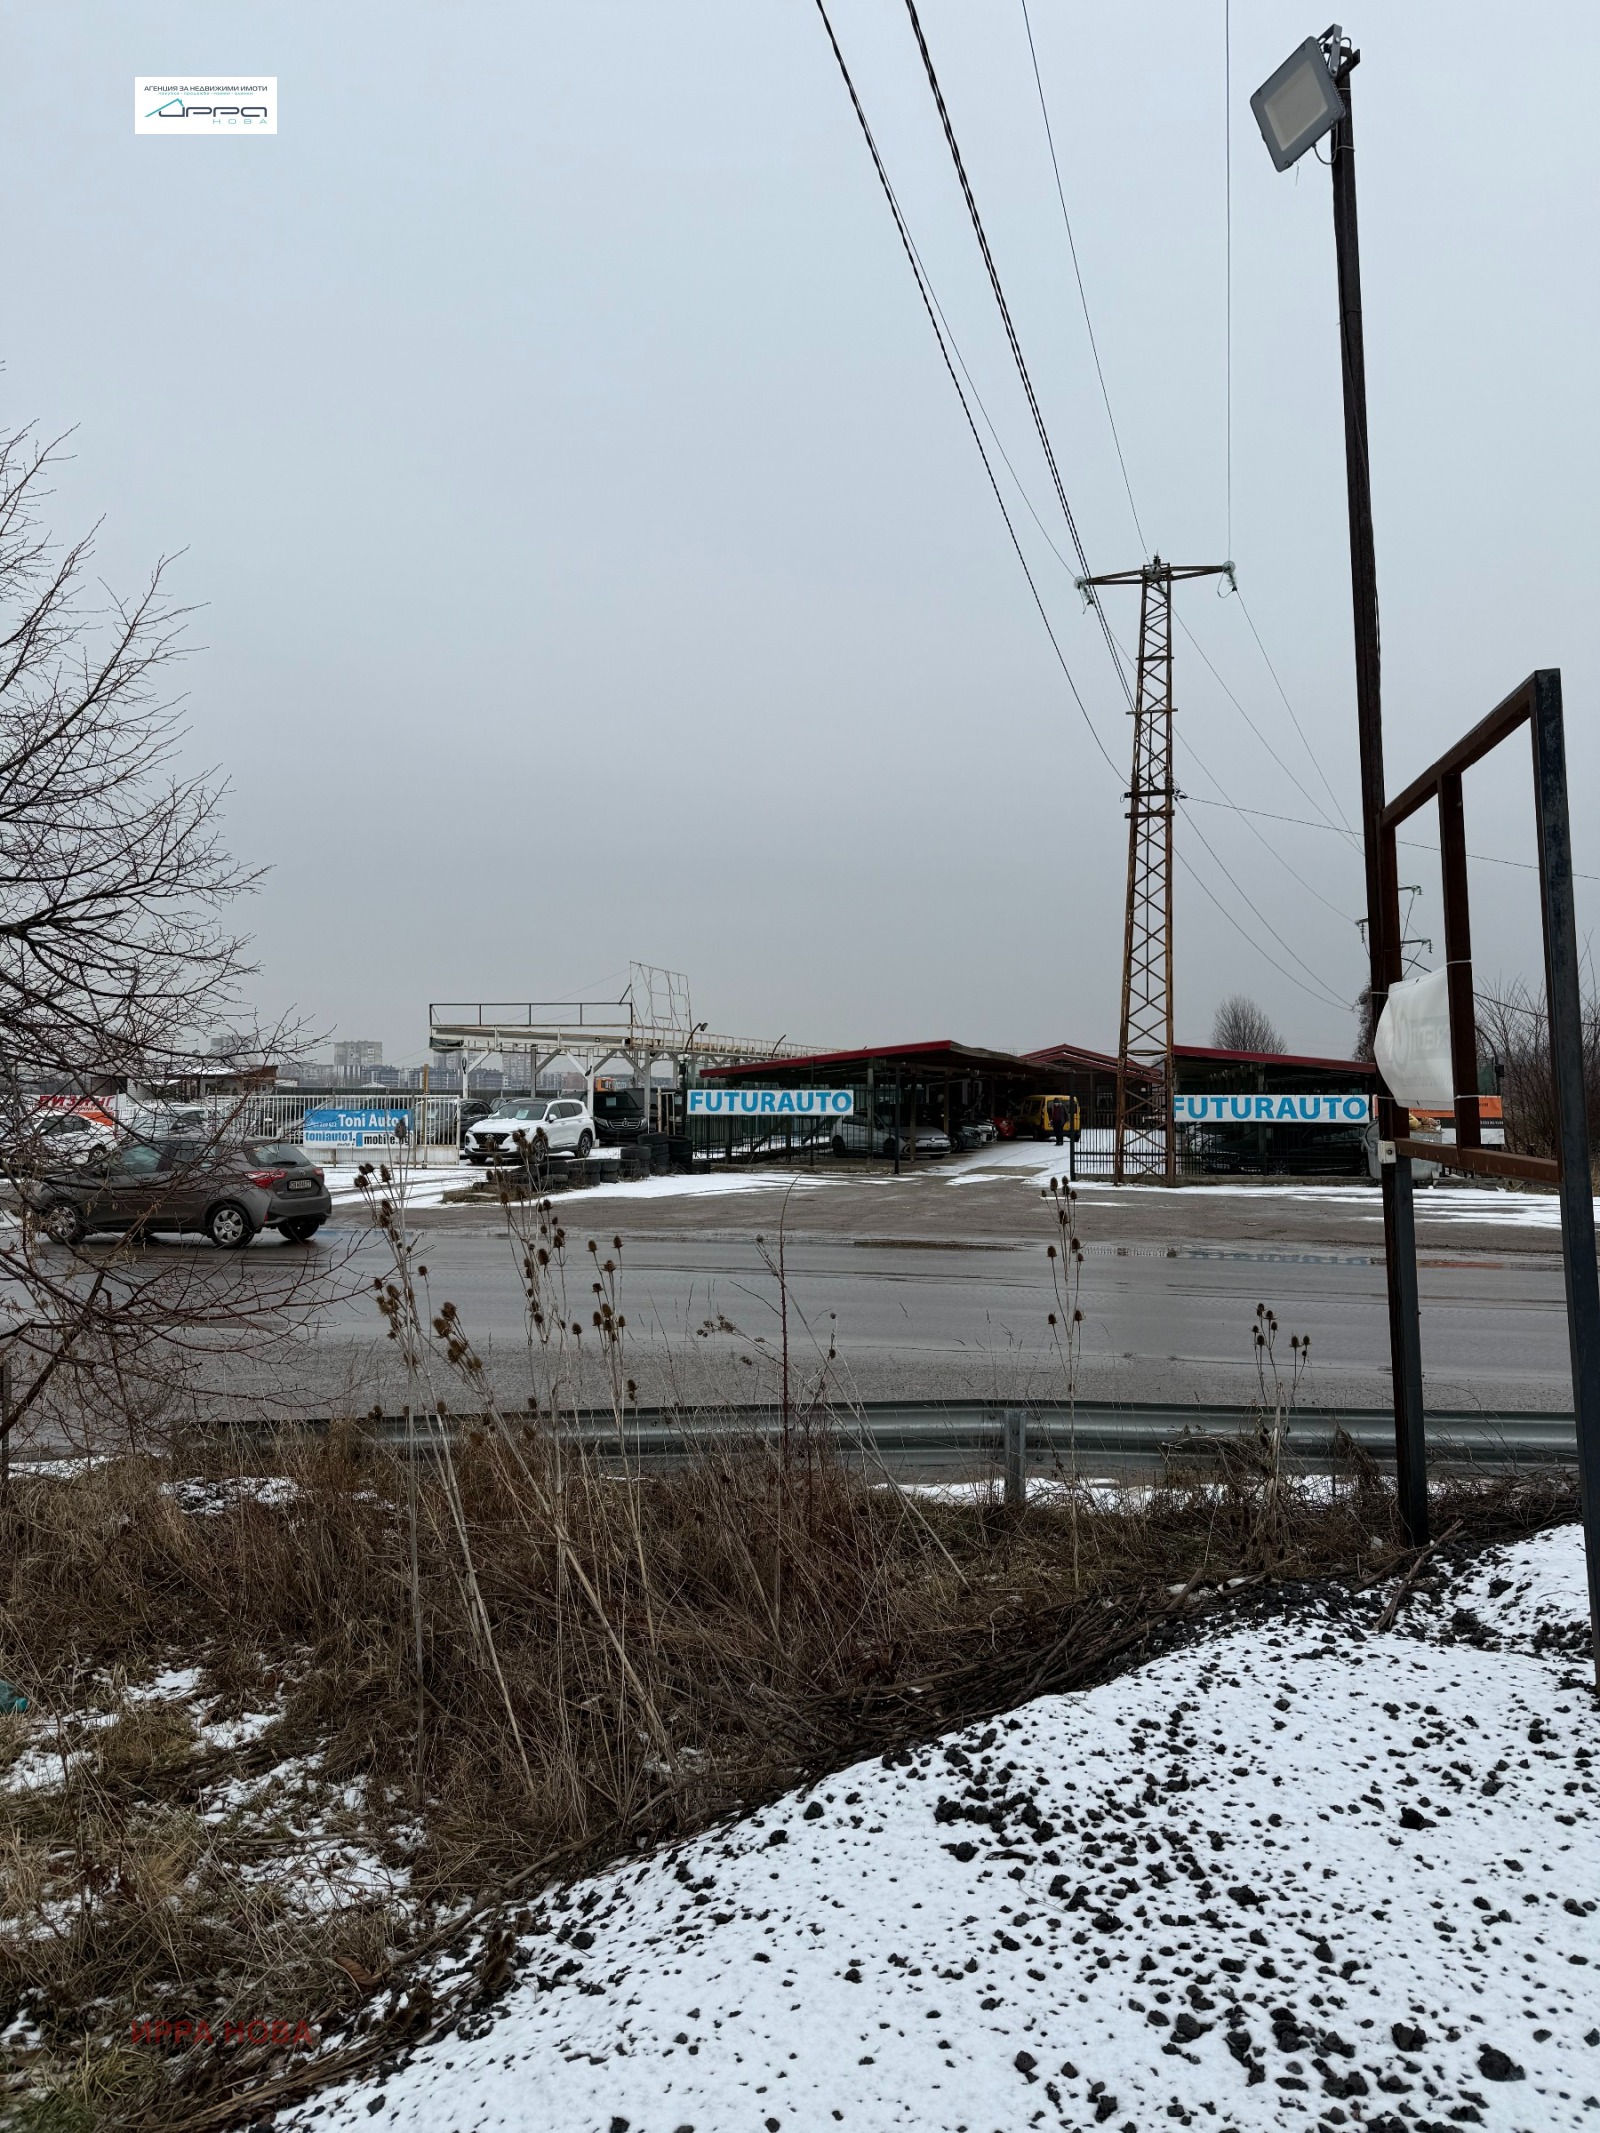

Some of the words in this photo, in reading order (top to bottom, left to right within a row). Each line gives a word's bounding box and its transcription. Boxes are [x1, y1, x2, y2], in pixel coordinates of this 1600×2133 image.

[689, 1091, 852, 1113] FUTURAUTO
[1174, 1096, 1367, 1120] FUTURAUTO
[338, 1113, 366, 1127] Toni
[368, 1114, 399, 1127] Auto
